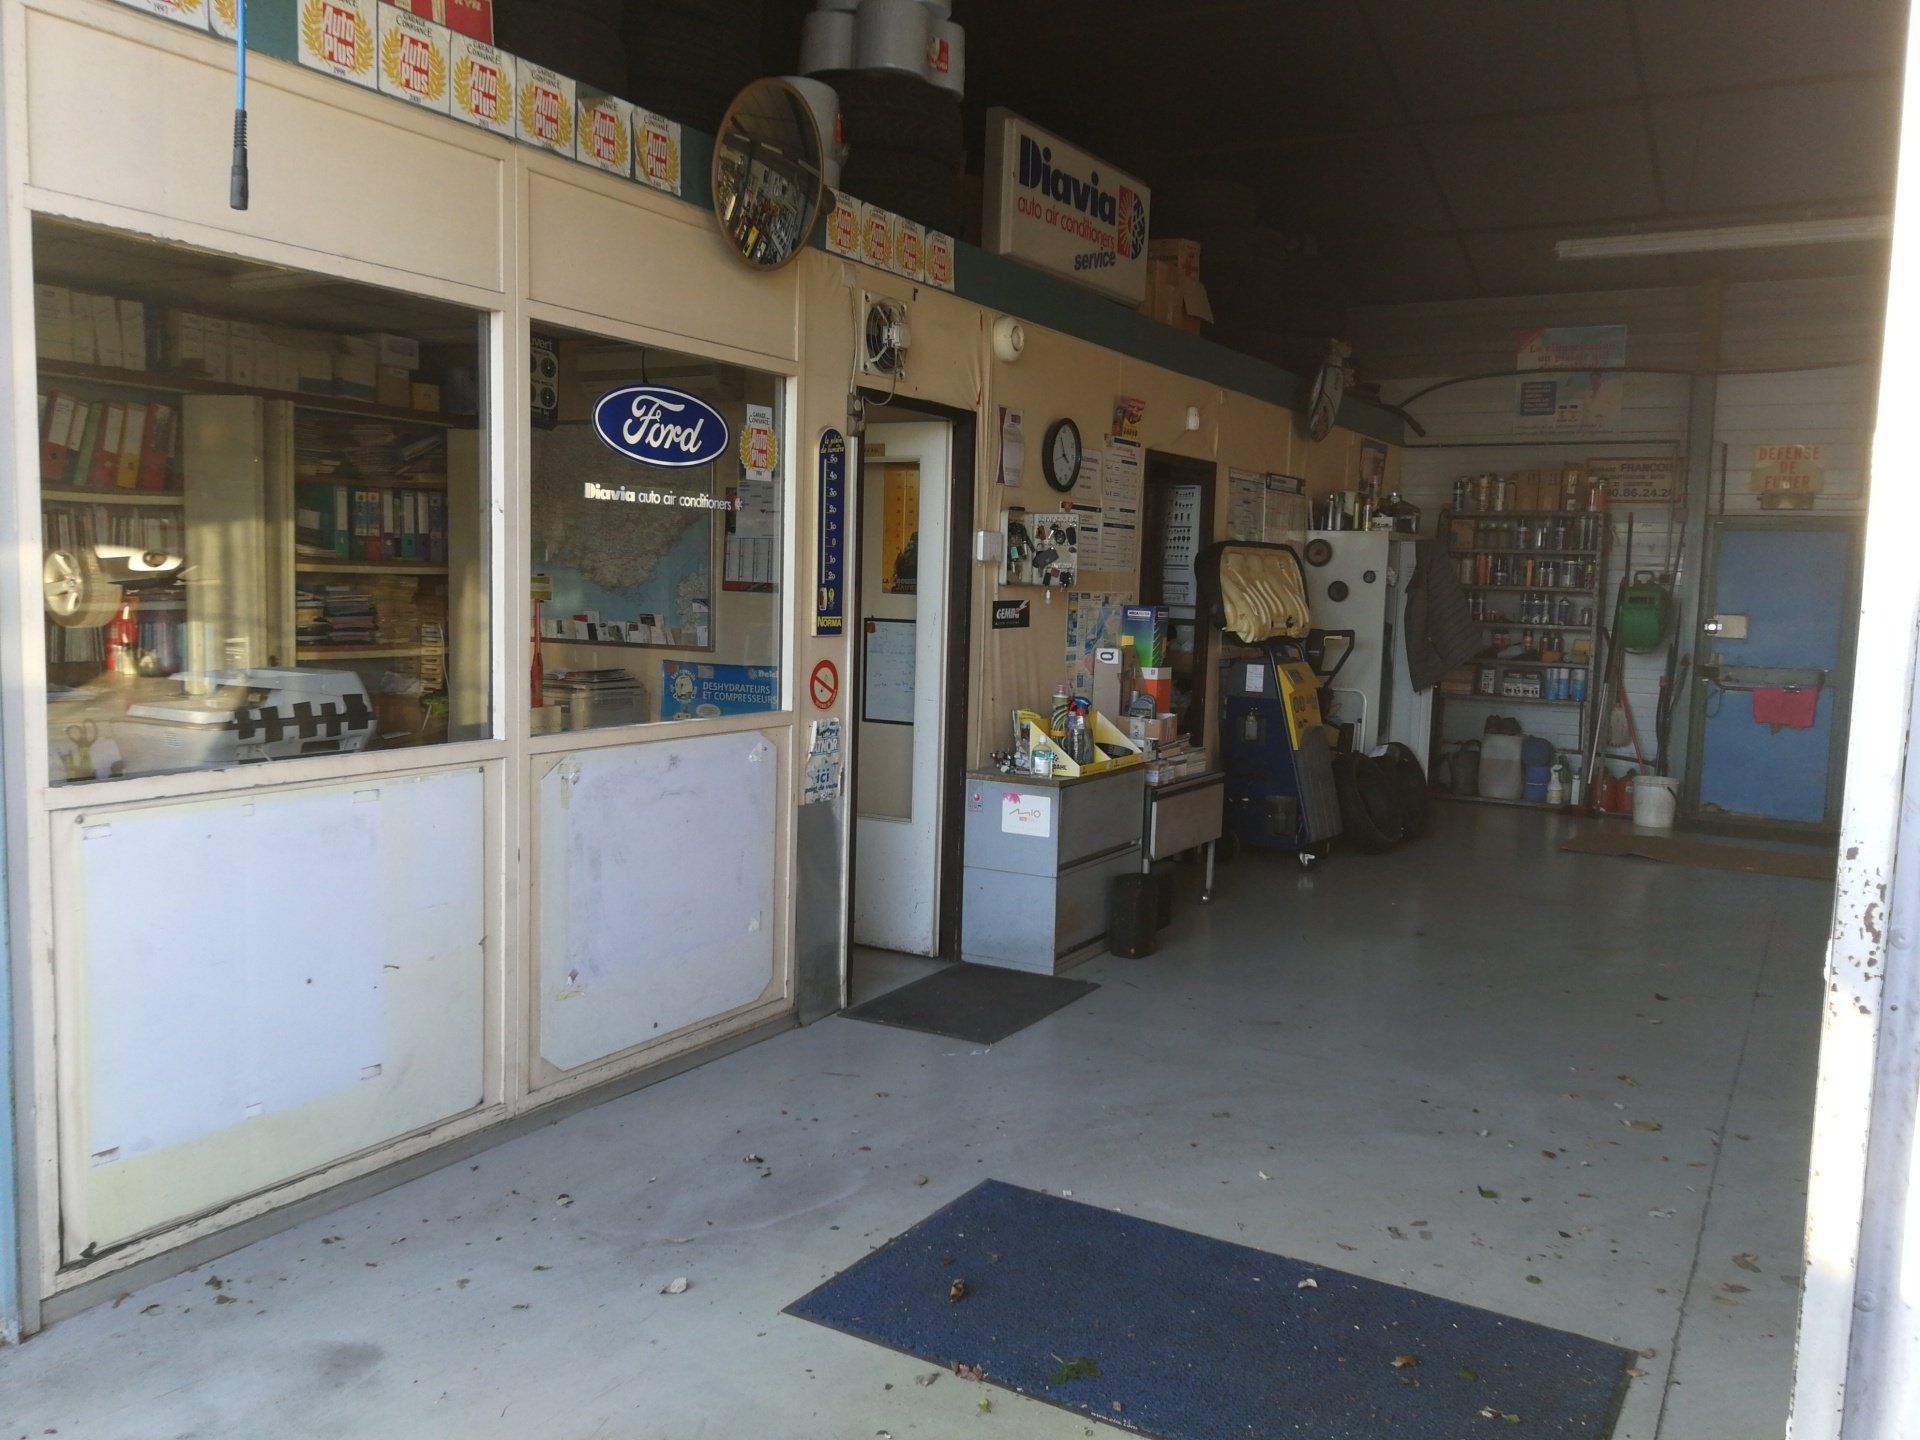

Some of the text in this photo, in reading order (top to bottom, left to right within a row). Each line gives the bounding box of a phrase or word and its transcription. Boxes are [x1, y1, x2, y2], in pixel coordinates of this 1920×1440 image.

[323, 6, 355, 45] Auto
[324, 35, 355, 69] Plus
[401, 36, 429, 70] Auto
[401, 60, 428, 95] Plus
[471, 62, 497, 94] Auto
[471, 90, 496, 119] Plus
[535, 88, 559, 118] Auto
[535, 113, 558, 142] Plus
[594, 112, 616, 140] Auto
[594, 134, 615, 162] Plus
[647, 133, 667, 158] Auto
[647, 154, 667, 180] Plus
[1019, 134, 1117, 226] Diavia
[1018, 196, 1115, 250] auto air conditioners
[1074, 247, 1116, 271] service
[622, 394, 704, 453] Ford
[751, 428, 768, 451] Auto
[751, 449, 768, 469] Plus
[829, 455, 838, 463] 50
[1759, 446, 1821, 460] DEFENSE
[829, 471, 837, 480] 40
[584, 482, 635, 502] Diavia
[638, 491, 661, 505] auto
[663, 491, 677, 505] air
[680, 493, 732, 511] conditioners
[828, 487, 837, 497] 30
[828, 504, 837, 513] 20
[829, 522, 836, 530] 10
[831, 538, 837, 546] 0
[829, 556, 836, 564] 10
[827, 572, 835, 580] 20
[817, 615, 842, 628] NORMA
[703, 681, 771, 694] DESHYDRATEURS
[703, 691, 777, 704] ET COMPRESSEURS
